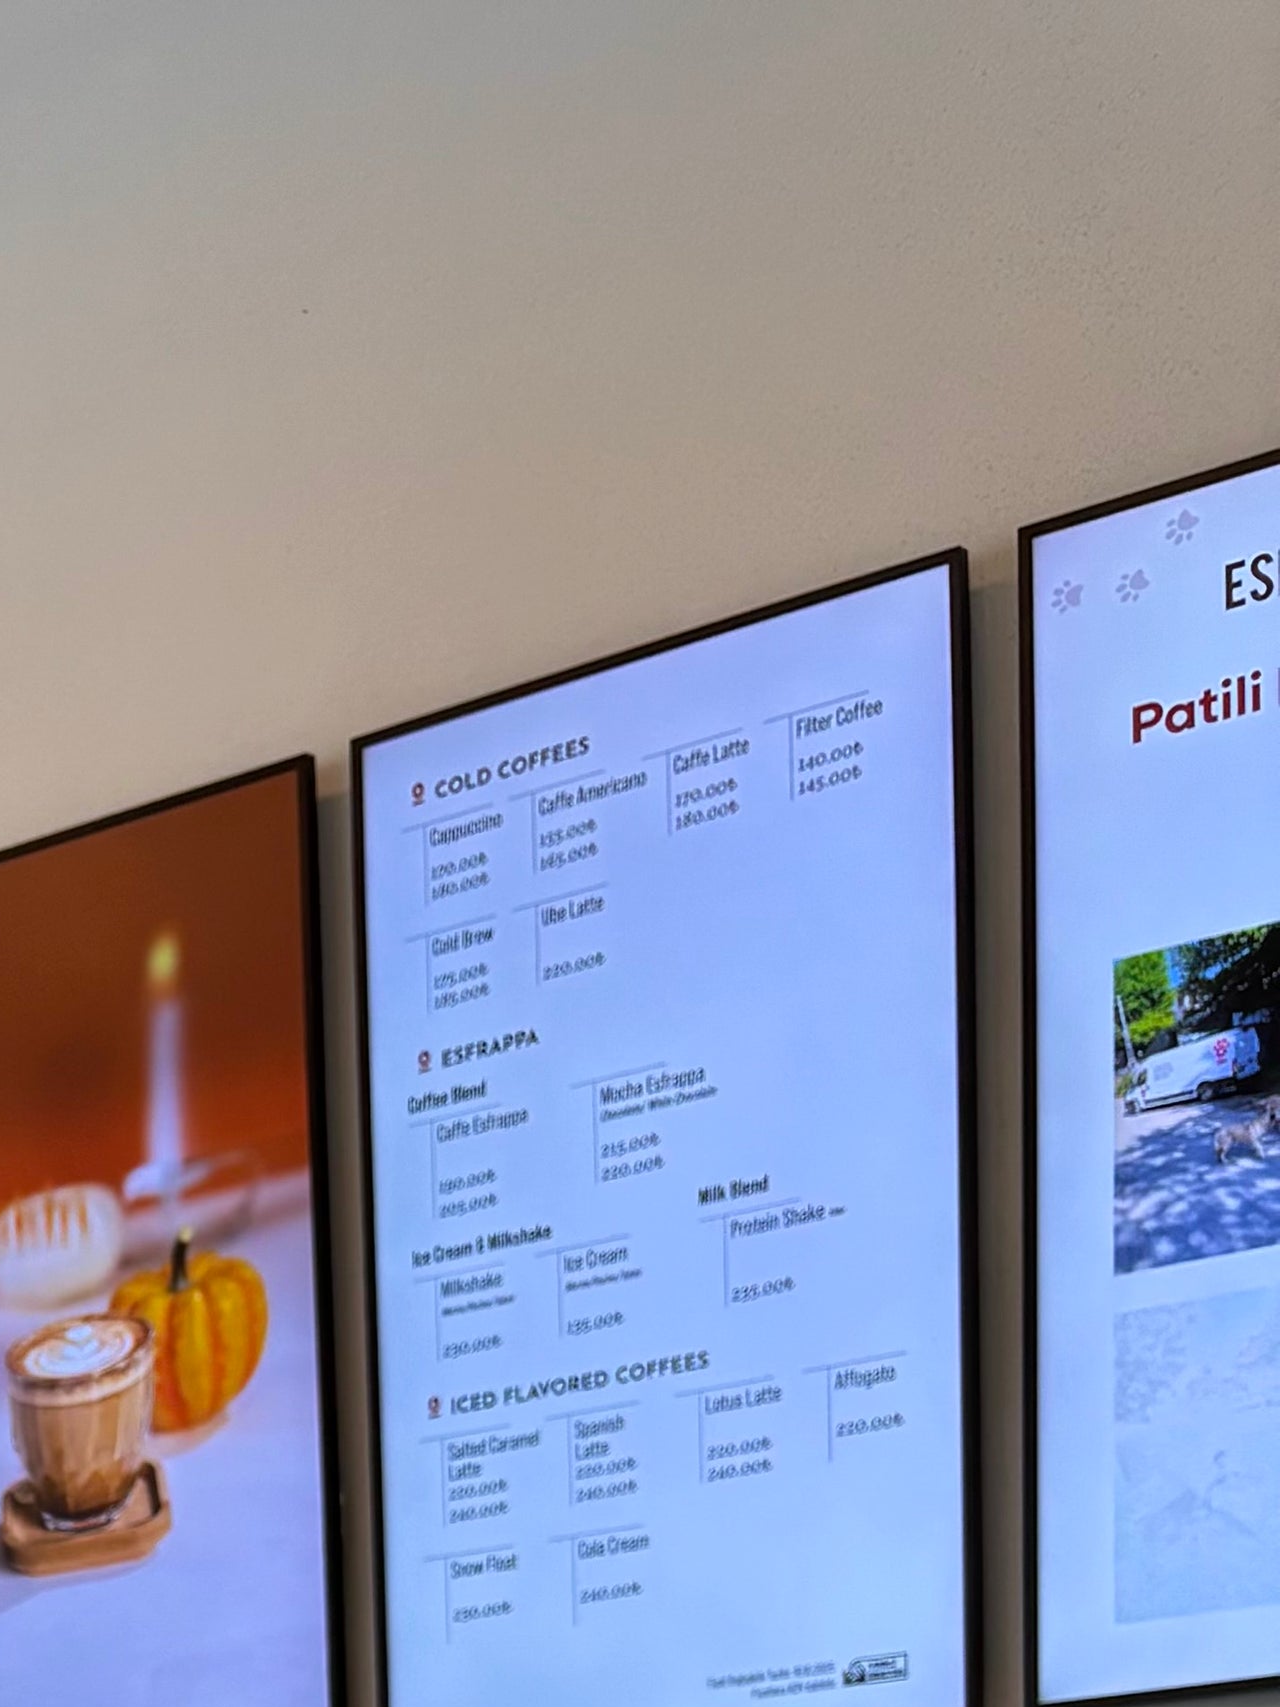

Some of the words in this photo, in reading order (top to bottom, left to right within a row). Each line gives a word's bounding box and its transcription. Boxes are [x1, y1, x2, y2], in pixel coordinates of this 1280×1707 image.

[1225, 549, 1280, 611] ES
[796, 713, 832, 739] Filter
[836, 699, 883, 728] Coffee
[1132, 669, 1262, 745] Patili
[435, 766, 491, 798] COLD
[497, 736, 590, 779] COFFEES
[673, 750, 710, 775] Caffe
[712, 738, 750, 764] Latte
[798, 741, 864, 773] 140.00₺
[576, 771, 647, 805] Americano
[799, 765, 863, 796] 145.00₺
[429, 813, 503, 847] Cappuccino
[569, 896, 605, 920] Latte
[432, 932, 459, 956] Cold
[461, 927, 494, 950] Brew
[441, 1028, 539, 1068] ESFRAPPA
[407, 1090, 448, 1115] Coffee
[451, 1079, 487, 1104] Blend
[600, 1080, 643, 1107] Mocha
[646, 1067, 706, 1095] Esfrappa
[698, 1184, 726, 1207] Milk
[730, 1173, 770, 1200] Blend
[730, 1211, 779, 1240] Protein
[783, 1204, 825, 1228] Shake
[412, 1250, 431, 1269] Ice
[433, 1241, 472, 1264] Cream
[487, 1224, 552, 1250] Milkshake
[563, 1254, 583, 1274] Ice
[586, 1247, 629, 1270] Cream
[440, 1272, 505, 1299] Milkshake
[450, 1390, 496, 1415] ICED
[504, 1370, 610, 1406] FLAVORED
[615, 1350, 710, 1384] COFFEES
[834, 1364, 897, 1390] Affogato
[705, 1395, 743, 1415] Lotus
[745, 1385, 783, 1408] Latte
[574, 1414, 625, 1440] Spanish
[447, 1436, 487, 1461] Salted
[489, 1429, 540, 1455] Caramel
[575, 1441, 611, 1461] Latte
[448, 1462, 482, 1482] Latte
[578, 1538, 605, 1560] Cola
[607, 1534, 650, 1555] Cream
[450, 1559, 483, 1580] Snow
[486, 1553, 517, 1574] Float
